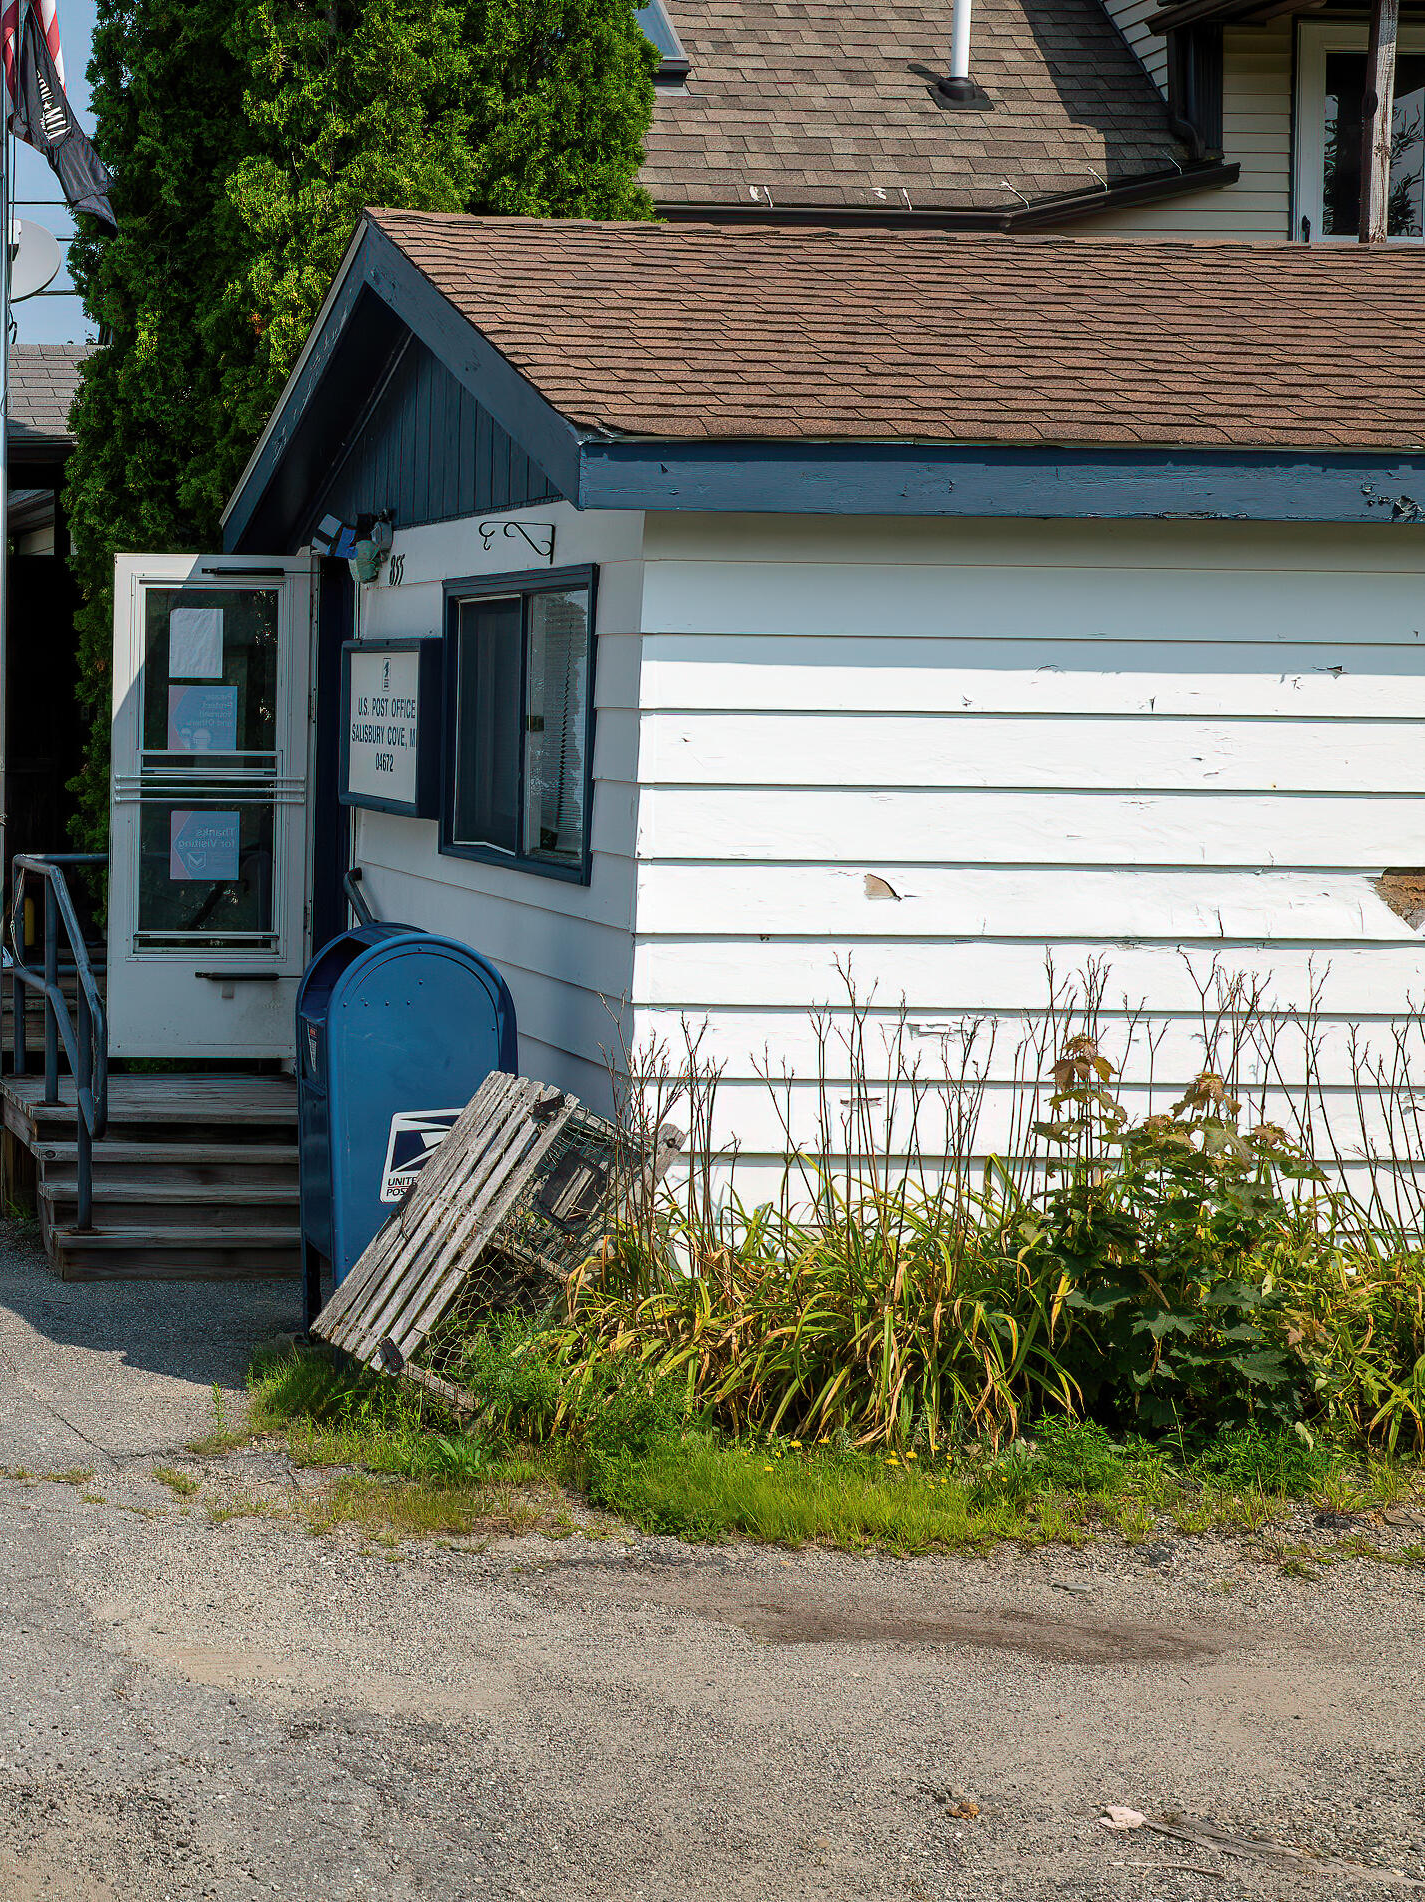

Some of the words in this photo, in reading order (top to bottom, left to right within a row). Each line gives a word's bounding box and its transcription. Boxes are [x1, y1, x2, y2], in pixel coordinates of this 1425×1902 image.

[45, 106, 71, 140] MIA
[358, 697, 370, 716] U.S.
[372, 697, 389, 717] POST
[391, 698, 416, 719] OFFICE
[351, 723, 385, 744] SALISBURY
[387, 725, 408, 752] COVE,
[409, 727, 417, 748] M
[375, 752, 394, 773] 04672
[386, 1187, 409, 1197] POS
[388, 1176, 418, 1187] UNITE
